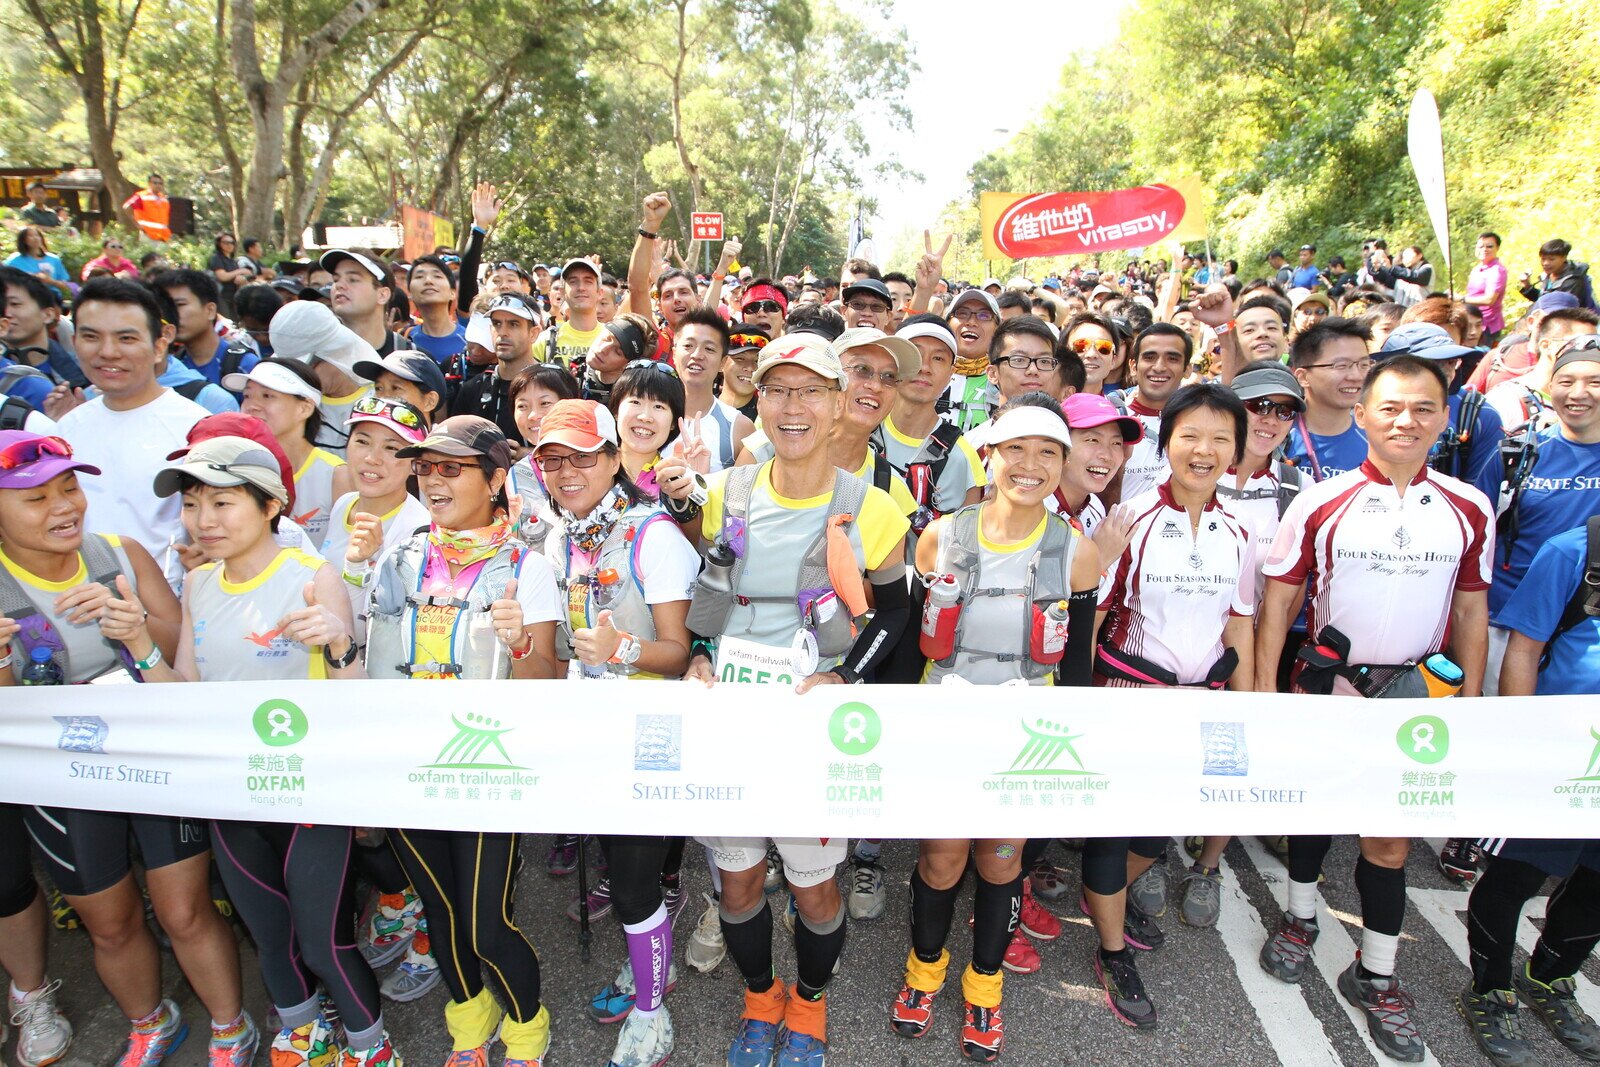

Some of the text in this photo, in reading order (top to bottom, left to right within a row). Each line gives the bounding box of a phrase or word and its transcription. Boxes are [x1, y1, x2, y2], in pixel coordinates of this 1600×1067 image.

[694, 216, 720, 225] SLOW
[1011, 203, 1094, 242] 維他奶
[556, 346, 591, 356] ADVAN
[1337, 549, 1458, 563] FOUR SEASONS HOTEL
[1366, 562, 1430, 578] Hong Kong
[1146, 573, 1236, 586] FOUR SEASONS HOTE
[1171, 584, 1219, 597] Hong Kong
[416, 614, 457, 626] tic UNIO
[728, 648, 793, 667] oxfam trailwalk
[248, 753, 305, 772] 樂施會
[69, 761, 172, 785] STATE STREET
[408, 769, 541, 786] oxfam trailwalker
[826, 762, 884, 782] 樂施會
[1401, 770, 1457, 788] 樂施會
[246, 775, 305, 792] OXFAM
[632, 782, 746, 801] STATE STREET
[982, 777, 1111, 791] oxfam trailwalker
[1553, 782, 1600, 794] oxfam
[250, 794, 304, 807] Hong Kong
[423, 785, 524, 801] 樂施毅行者
[826, 785, 883, 802] OXFAM
[999, 793, 1097, 807] 樂施毅行者
[1199, 786, 1308, 804] STATE STREET
[1398, 790, 1454, 806] OXFAM
[828, 806, 881, 818] Hong Kong
[1007, 895, 1021, 933] 2XU
